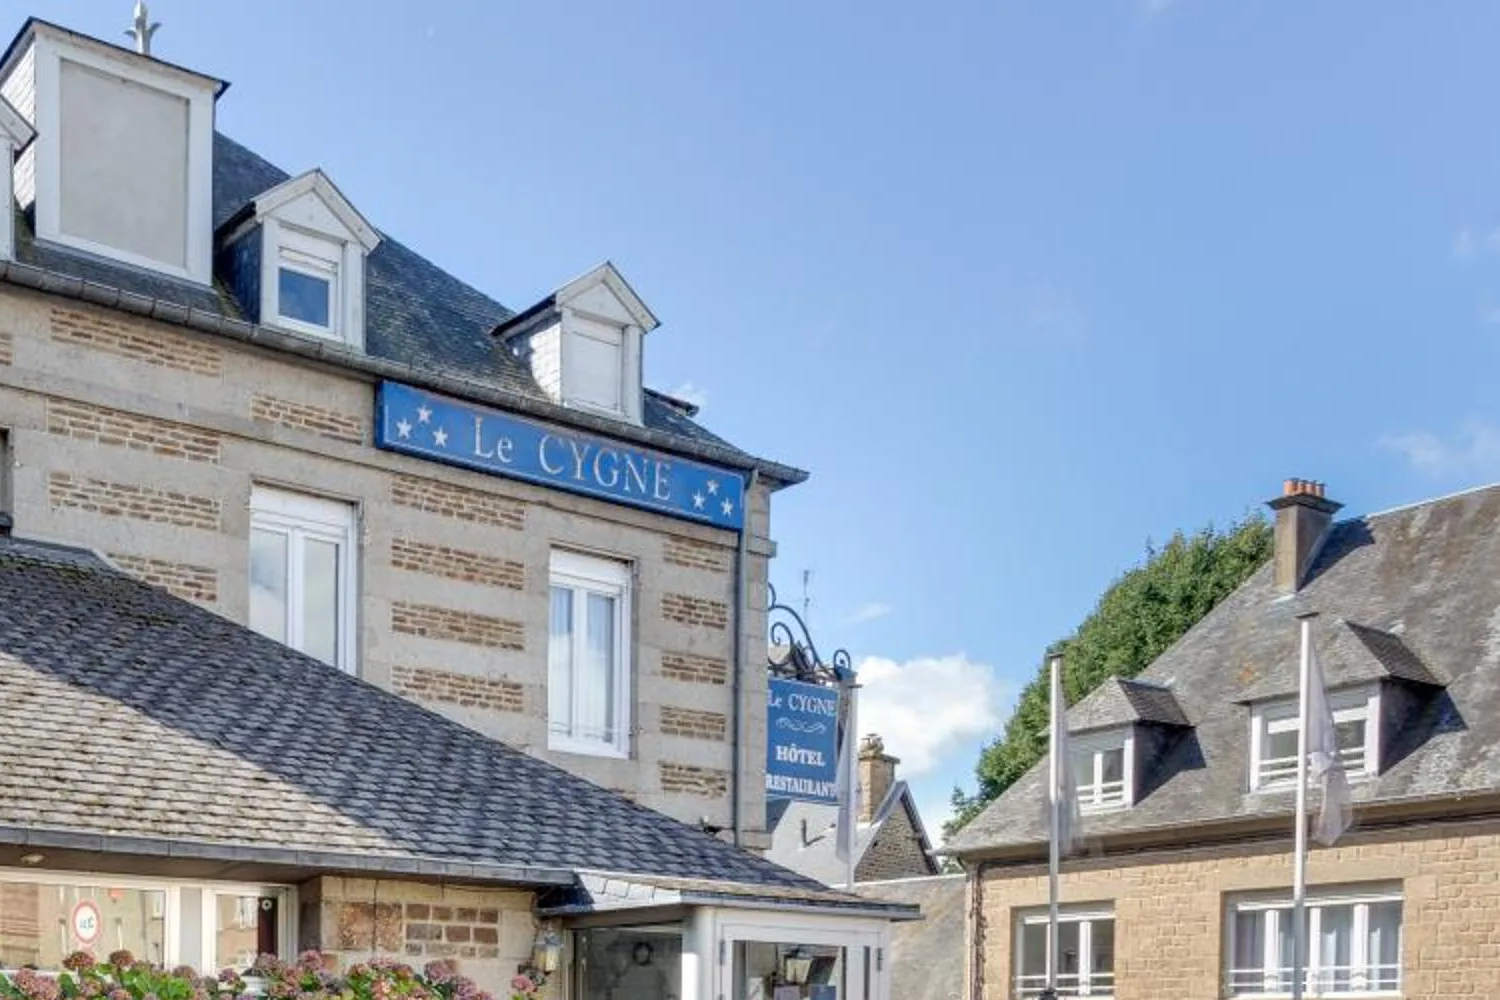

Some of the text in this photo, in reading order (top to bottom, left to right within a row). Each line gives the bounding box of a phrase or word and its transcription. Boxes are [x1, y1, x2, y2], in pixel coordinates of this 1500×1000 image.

[474, 415, 672, 501] Le CYGNE
[787, 693, 837, 717] CYGNE
[775, 743, 826, 768] HÔTEL
